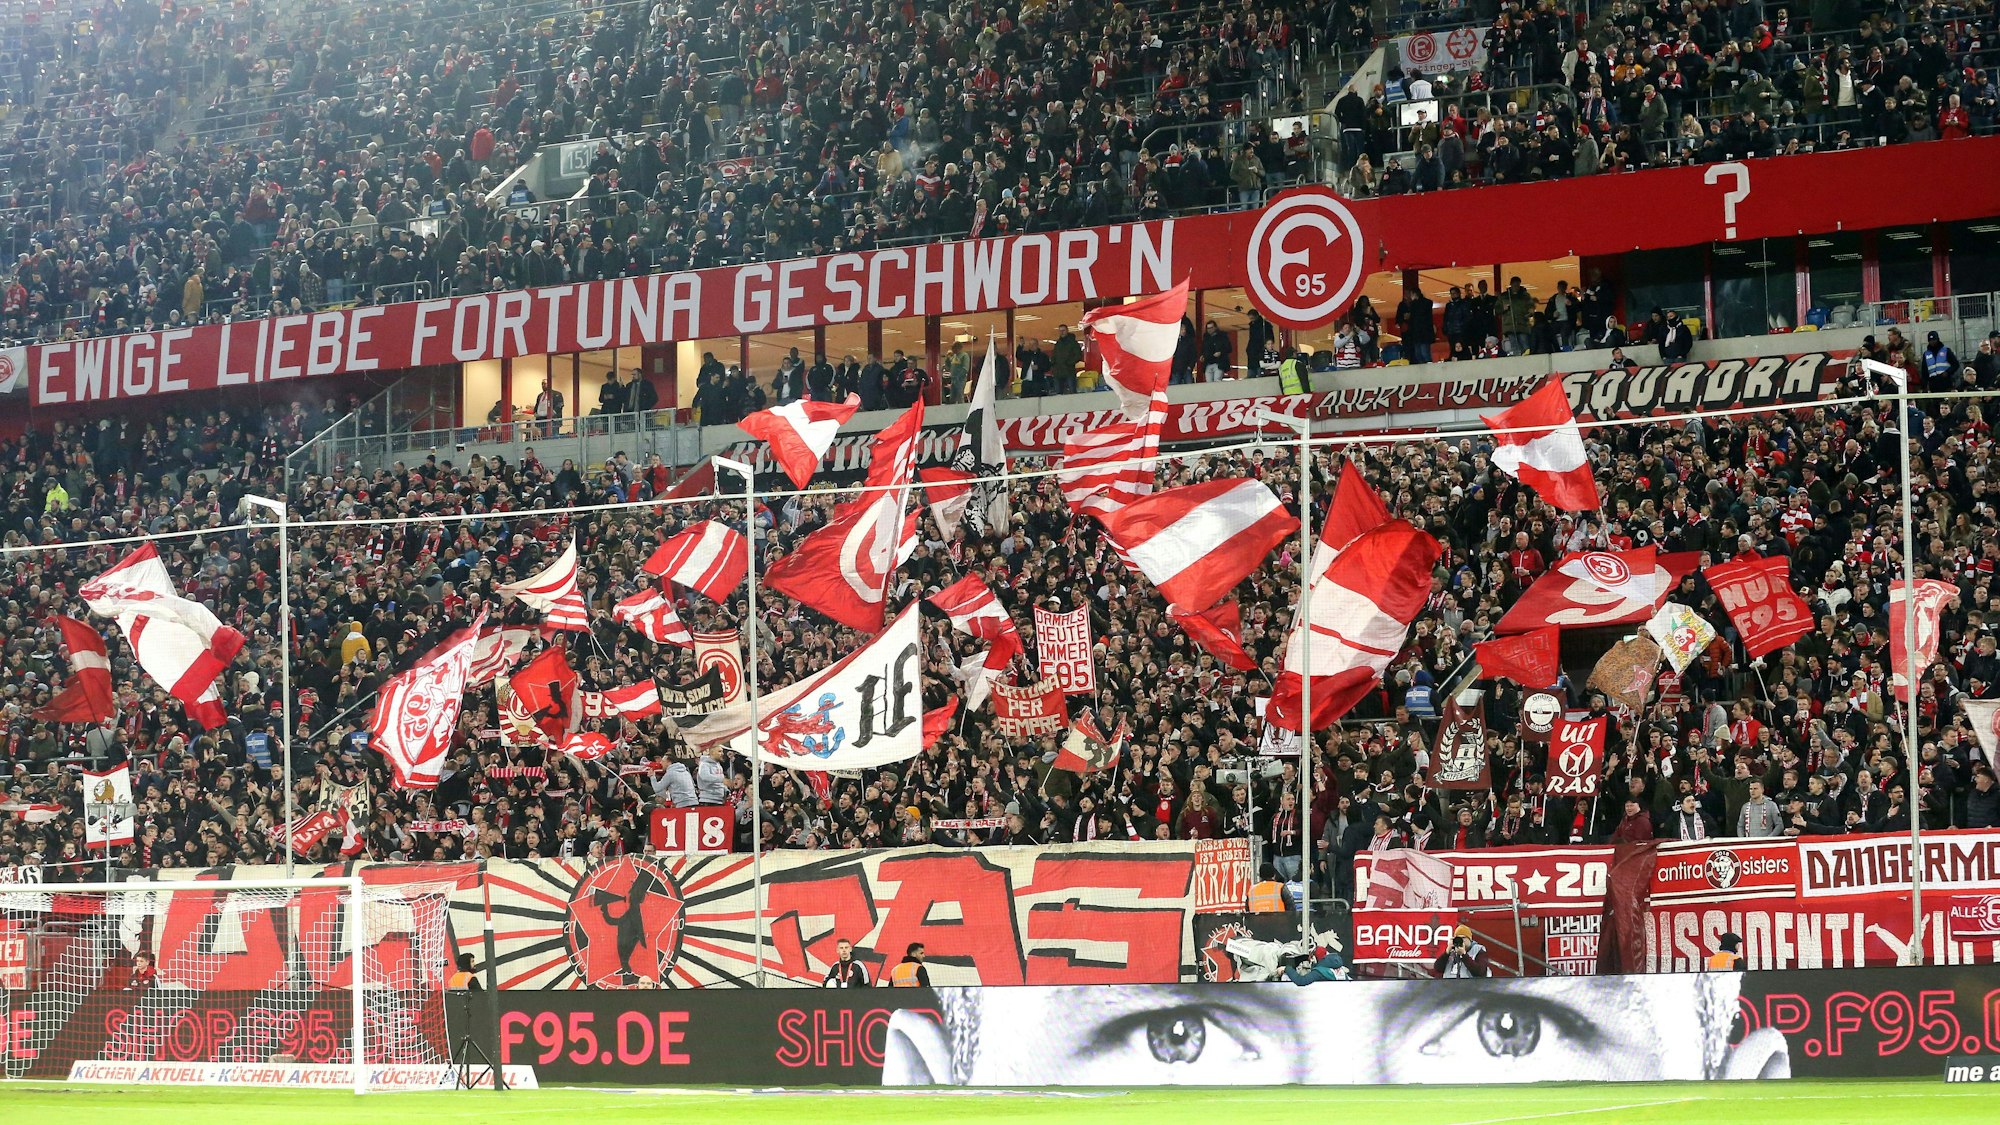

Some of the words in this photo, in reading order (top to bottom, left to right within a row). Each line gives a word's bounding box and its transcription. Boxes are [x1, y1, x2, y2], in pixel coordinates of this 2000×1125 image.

[1703, 162, 1751, 239] ?
[1296, 273, 1327, 297] 95
[39, 328, 193, 405] EWIGE
[217, 306, 385, 386] LIEBE
[411, 272, 702, 367] FORTUNA
[733, 220, 1174, 334] GESCHWOR'N
[1562, 352, 1828, 420] SQUADRA
[1035, 609, 1085, 624] DAMALS
[1733, 598, 1798, 638] F95
[1038, 623, 1087, 642] HEUTE
[1039, 641, 1089, 660] IMMER
[1007, 698, 1044, 717] PER
[1000, 713, 1063, 737] SEMPRE
[1560, 722, 1599, 744] ULT
[1547, 774, 1597, 795] RAS
[1658, 861, 1703, 882] antira
[1742, 855, 1790, 875] sisters
[1951, 906, 1987, 918] ALLES
[1356, 924, 1453, 946] BANDA
[75, 1065, 137, 1081] KÜCHEN
[138, 1067, 205, 1082] AKTUELL
[218, 1065, 284, 1083] KÜCHEN
